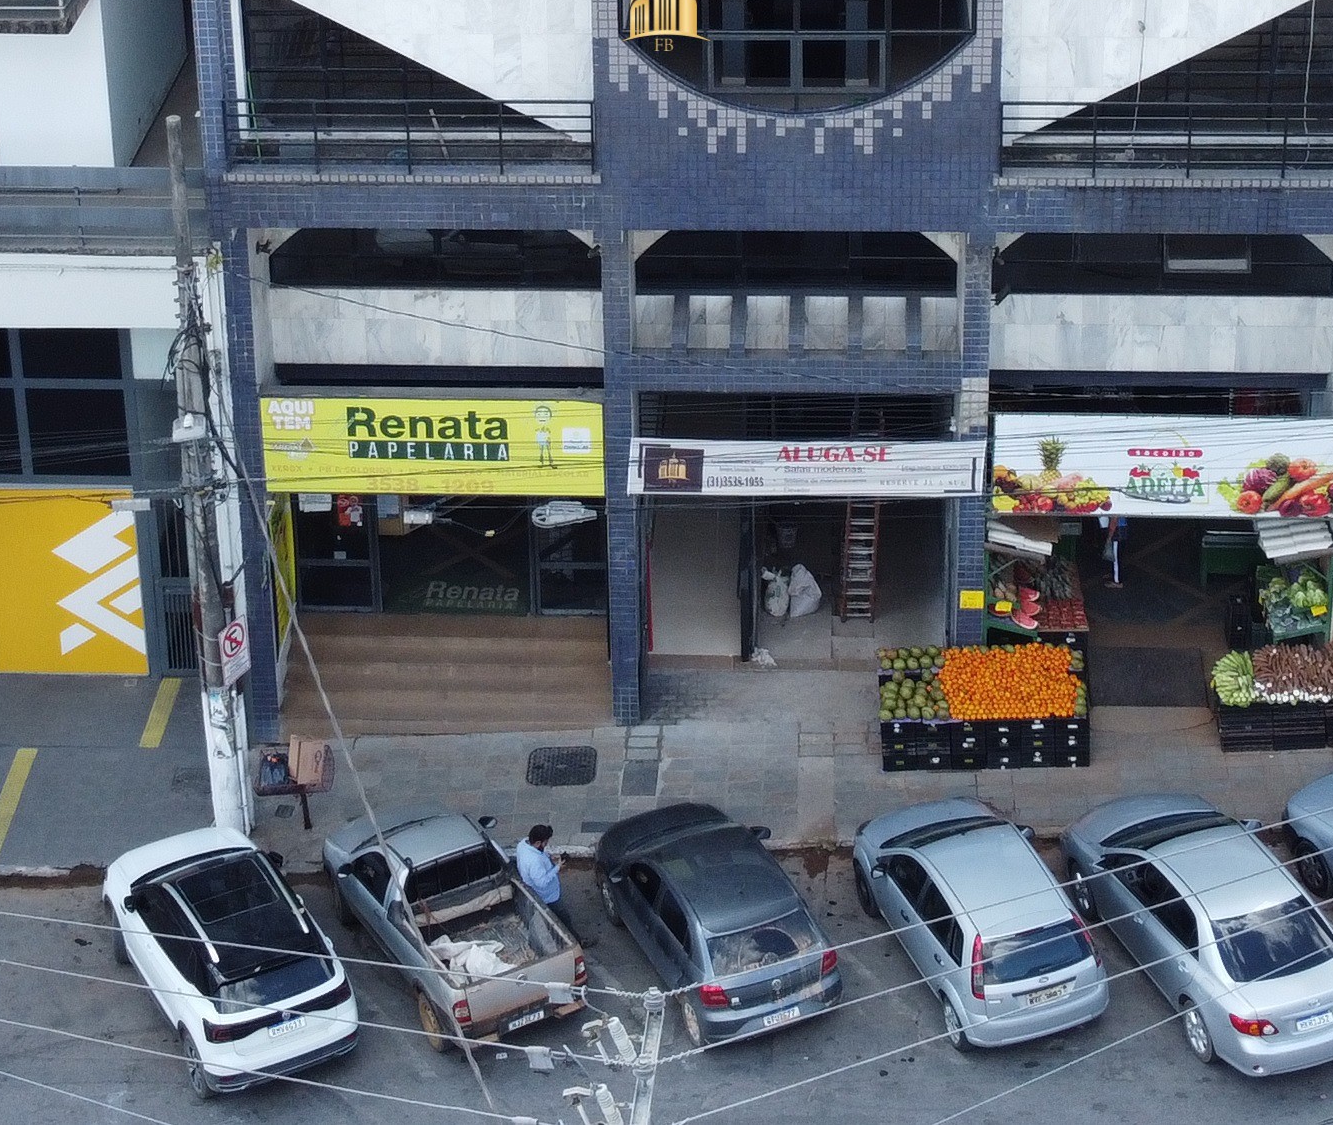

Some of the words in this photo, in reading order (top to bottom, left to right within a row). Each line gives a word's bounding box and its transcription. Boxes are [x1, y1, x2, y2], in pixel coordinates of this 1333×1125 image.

[268, 400, 315, 415] AQUI
[272, 416, 311, 430] TEM
[346, 407, 509, 441] Renata
[349, 442, 509, 461] PAPELARIA
[777, 446, 893, 463] ALUGA-SE
[367, 478, 419, 492] 3538
[425, 580, 520, 602] Renata
